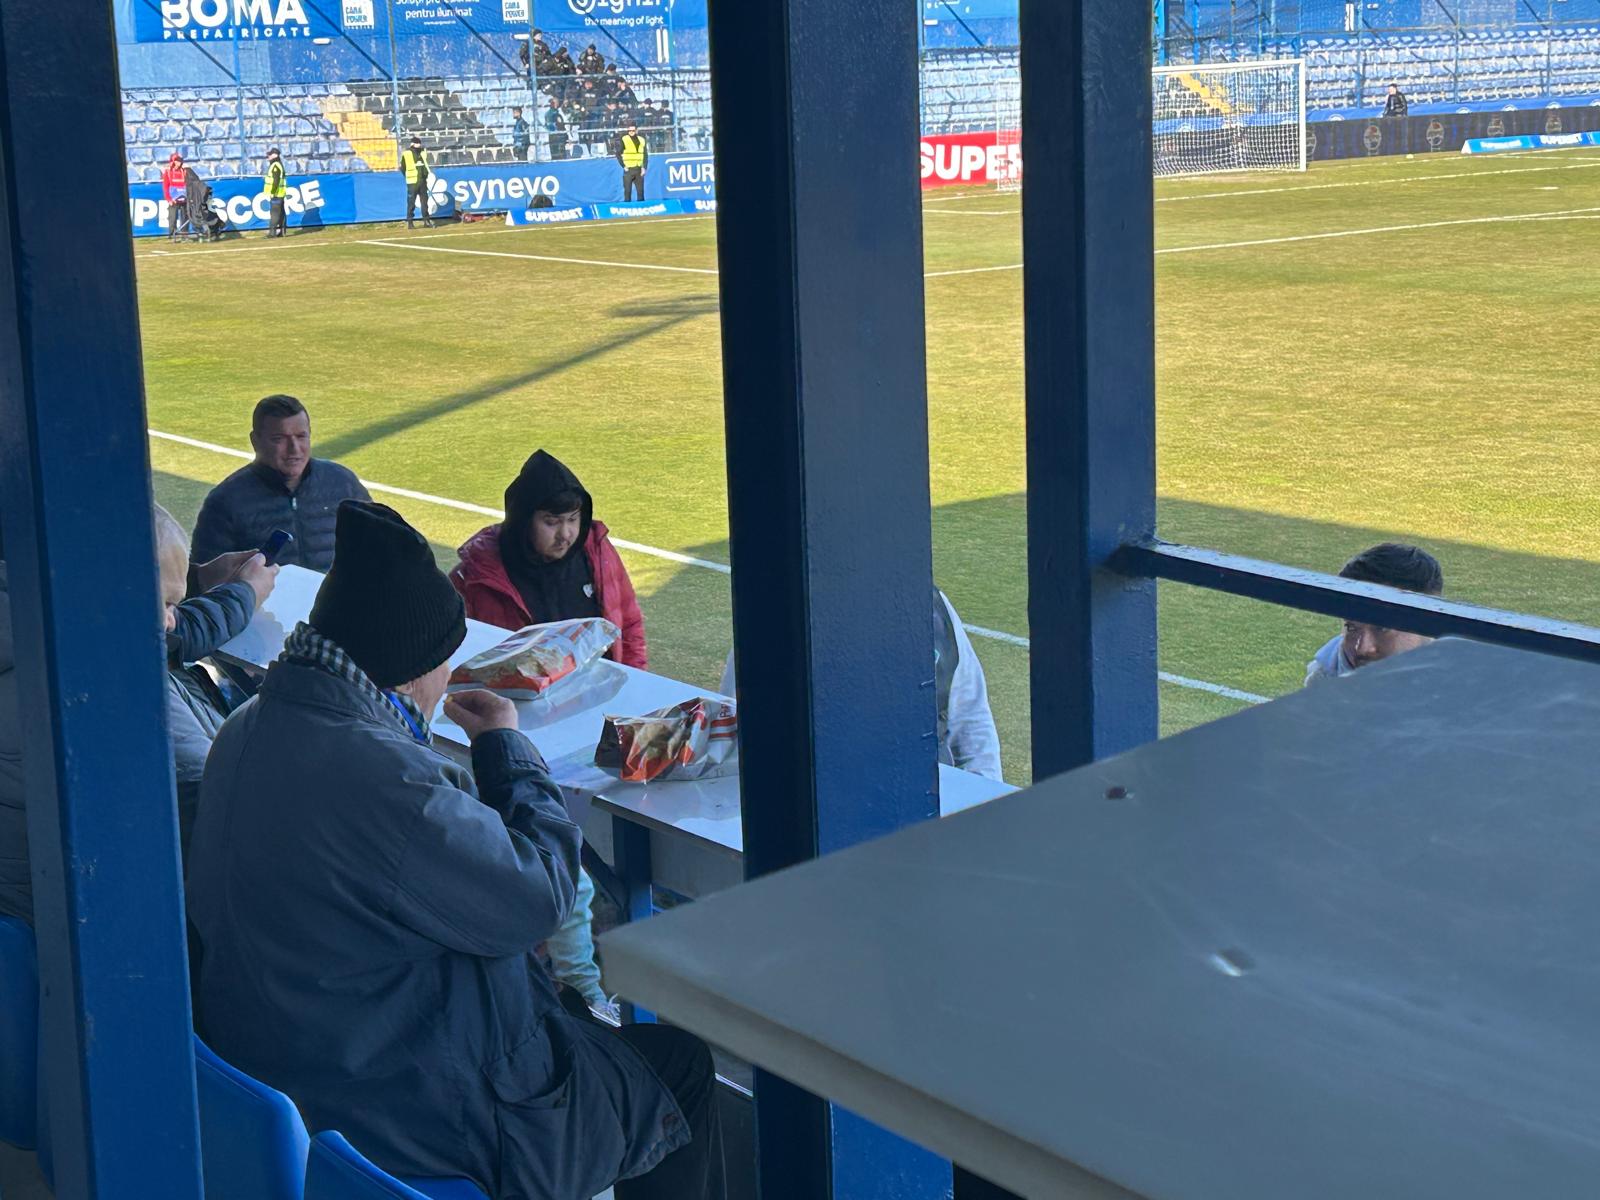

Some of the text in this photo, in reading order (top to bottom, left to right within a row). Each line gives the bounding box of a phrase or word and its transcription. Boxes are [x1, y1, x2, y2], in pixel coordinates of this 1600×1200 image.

[161, 0, 309, 28] BOMA
[405, 8, 435, 20] pentru
[600, 16, 634, 27] meaning
[635, 16, 645, 25] of
[645, 15, 664, 27] light
[454, 175, 560, 209] synevo
[525, 207, 583, 222] SUPERBET
